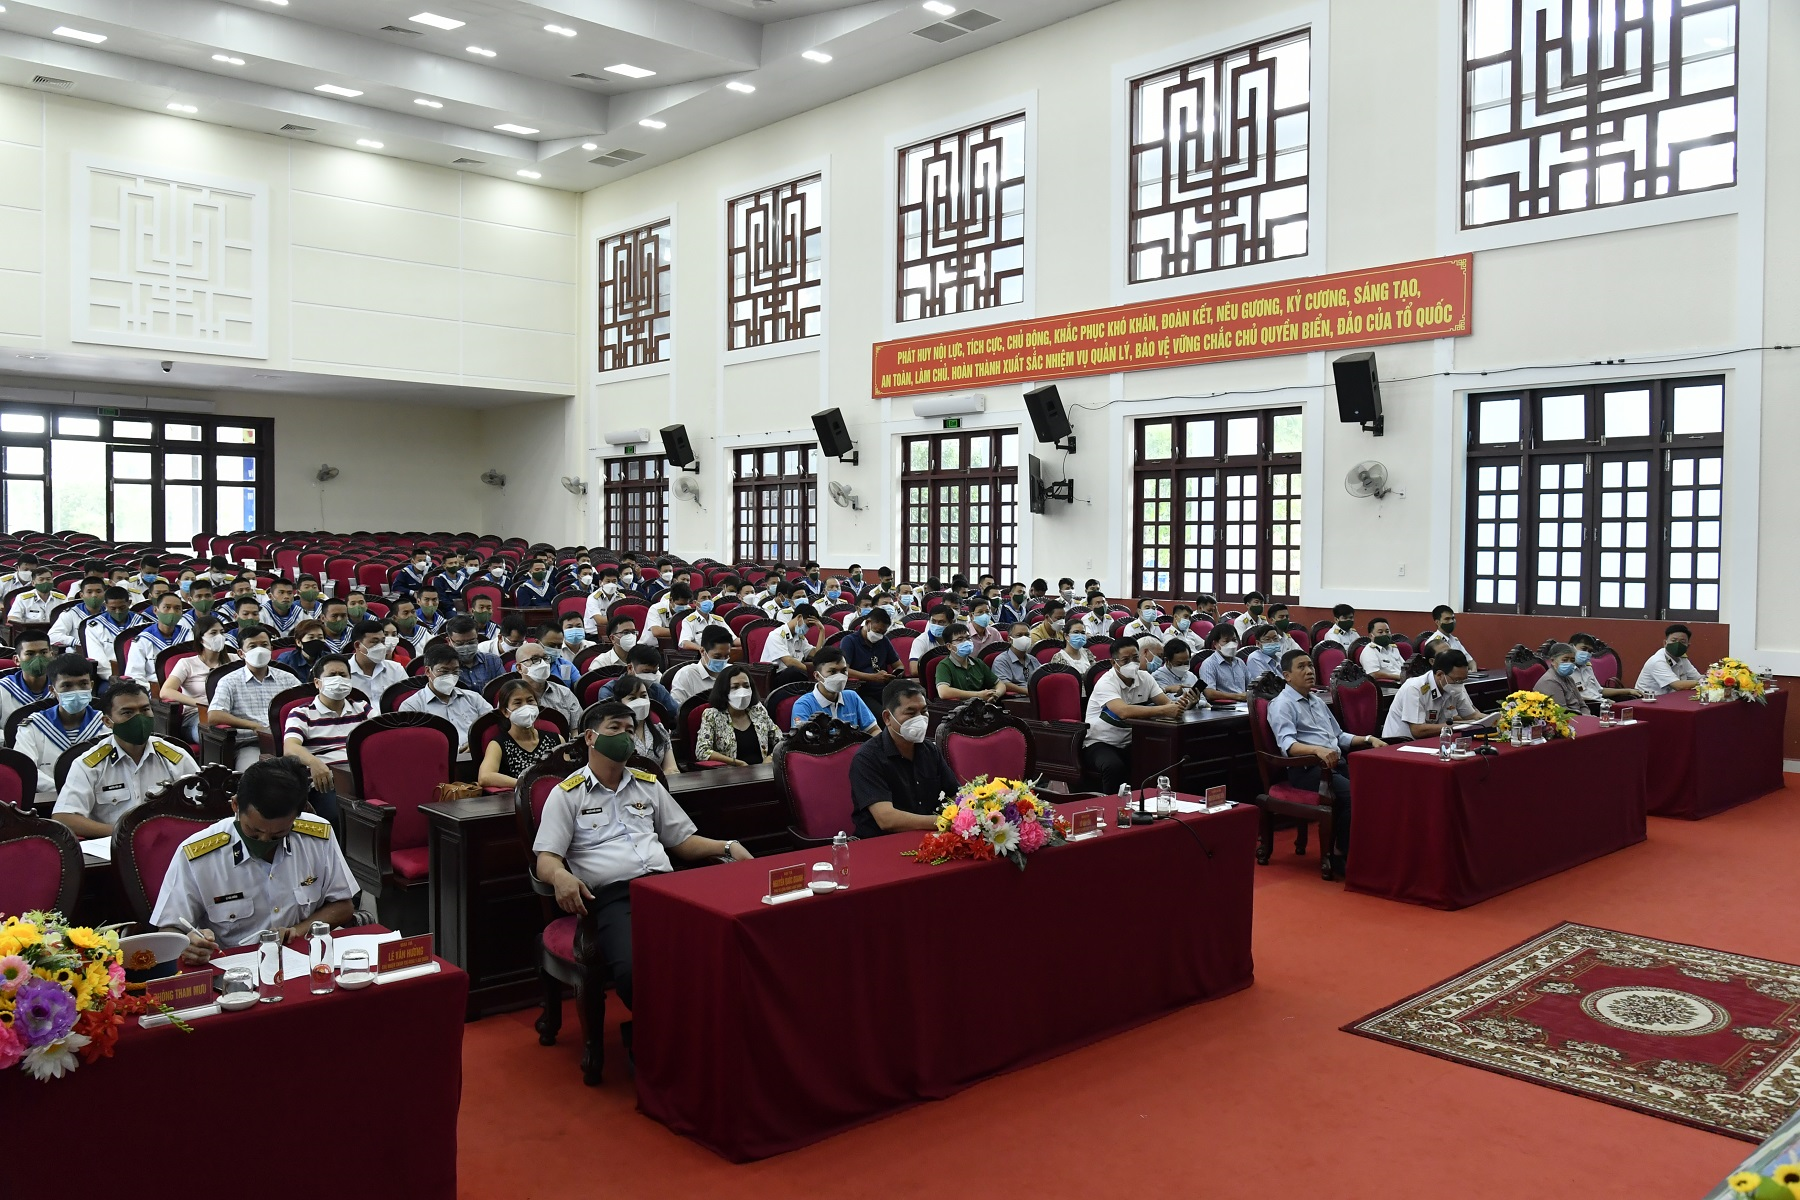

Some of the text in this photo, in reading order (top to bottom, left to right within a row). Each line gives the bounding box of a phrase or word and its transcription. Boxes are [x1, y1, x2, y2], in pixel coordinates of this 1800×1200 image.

[881, 374, 891, 388] AN
[893, 369, 913, 387] TOÀN,
[915, 367, 931, 384] LÀM
[951, 362, 973, 380] HOÀN
[975, 359, 1001, 377] THÀNH
[1002, 353, 1024, 374] XUẤT
[1026, 350, 1043, 371] SẮC
[1045, 349, 1075, 370] NHIỆM
[1076, 350, 1088, 368] VỤ
[1090, 342, 1116, 365] QUẢN
[1118, 341, 1133, 361] LÝ,
[1135, 336, 1155, 359] BẢO
[1158, 334, 1170, 358] VỆ
[1173, 333, 1201, 354] VỮNG
[1203, 326, 1232, 350] CHẮC
[1235, 322, 1258, 347] CHỦ
[1260, 318, 1299, 346] QUYỀN
[1301, 312, 1334, 340] BIỂN,
[1337, 310, 1363, 336] ĐẢO
[1366, 306, 1392, 332] CỦA
[1396, 301, 1413, 328] TỔ
[1415, 298, 1453, 328] QUỐC
[897, 278, 1421, 365] PHÁT HUY NỘI LỰC, TÍCH CỰC, CHỦ ĐỘNG, KHẮC PHỤC KHÓ KHĂN, ĐOÀN KẾT, NÊU GƯƠNG, KỶ CƯƠNG, SÁNG TẠO,
[175, 986, 192, 999] THAM
